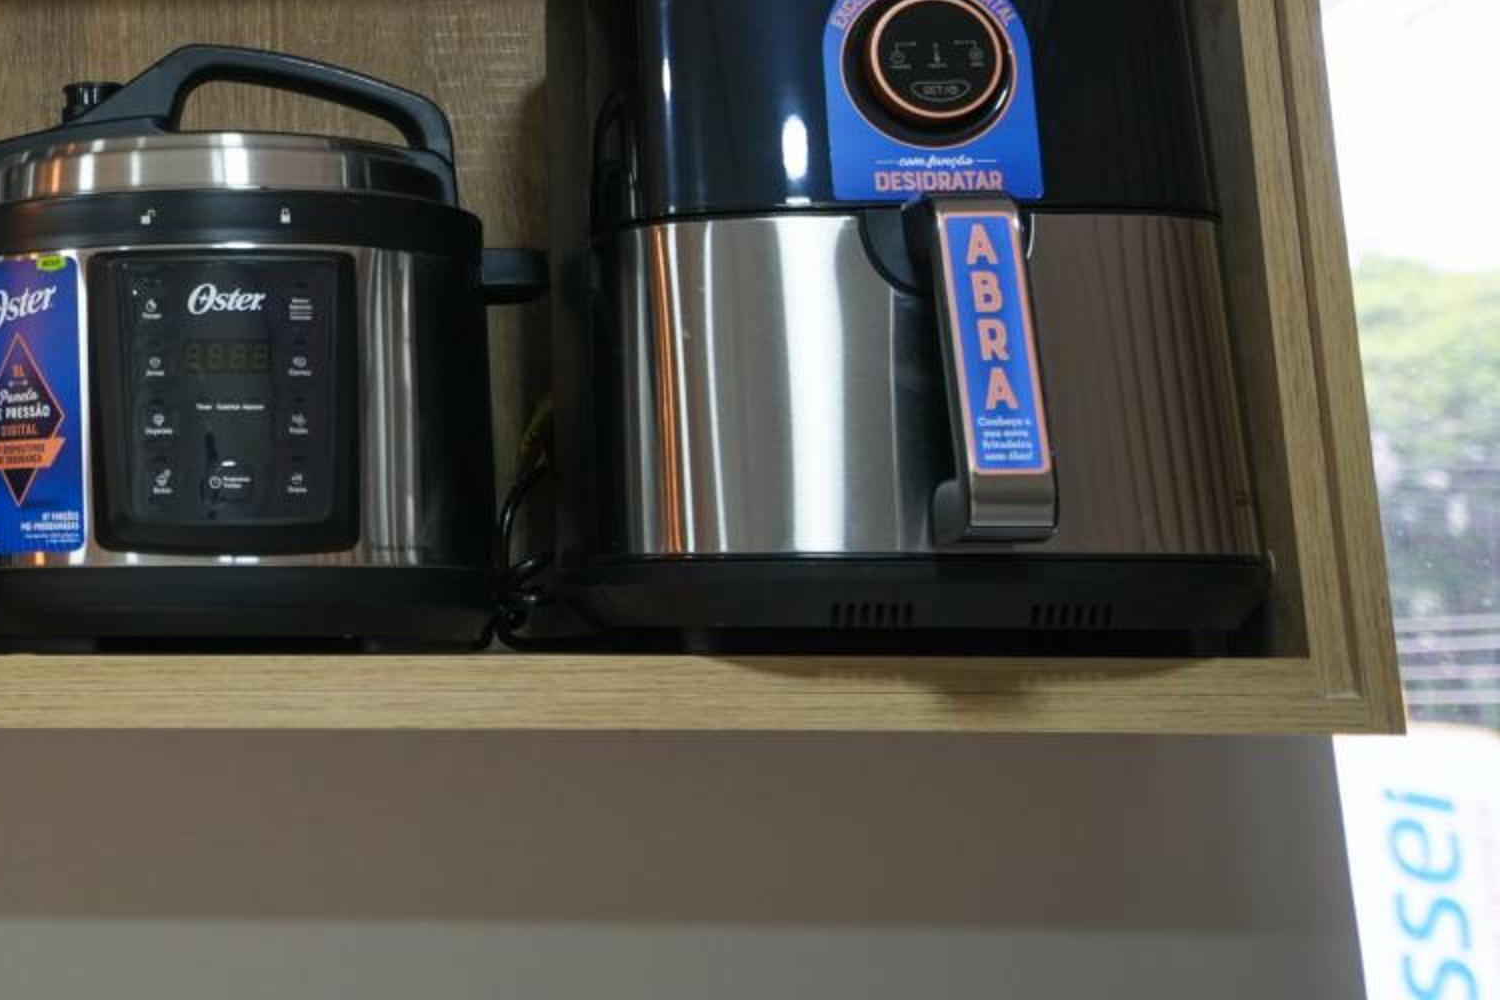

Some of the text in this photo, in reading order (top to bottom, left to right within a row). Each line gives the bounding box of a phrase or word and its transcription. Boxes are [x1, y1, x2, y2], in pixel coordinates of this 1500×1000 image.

[875, 171, 1003, 191] DESIDRATAR
[187, 283, 266, 315] Oster
[966, 223, 1020, 409] ABRA
[5, 402, 50, 420] PRESSÃO
[1, 423, 38, 437] DIGITAL
